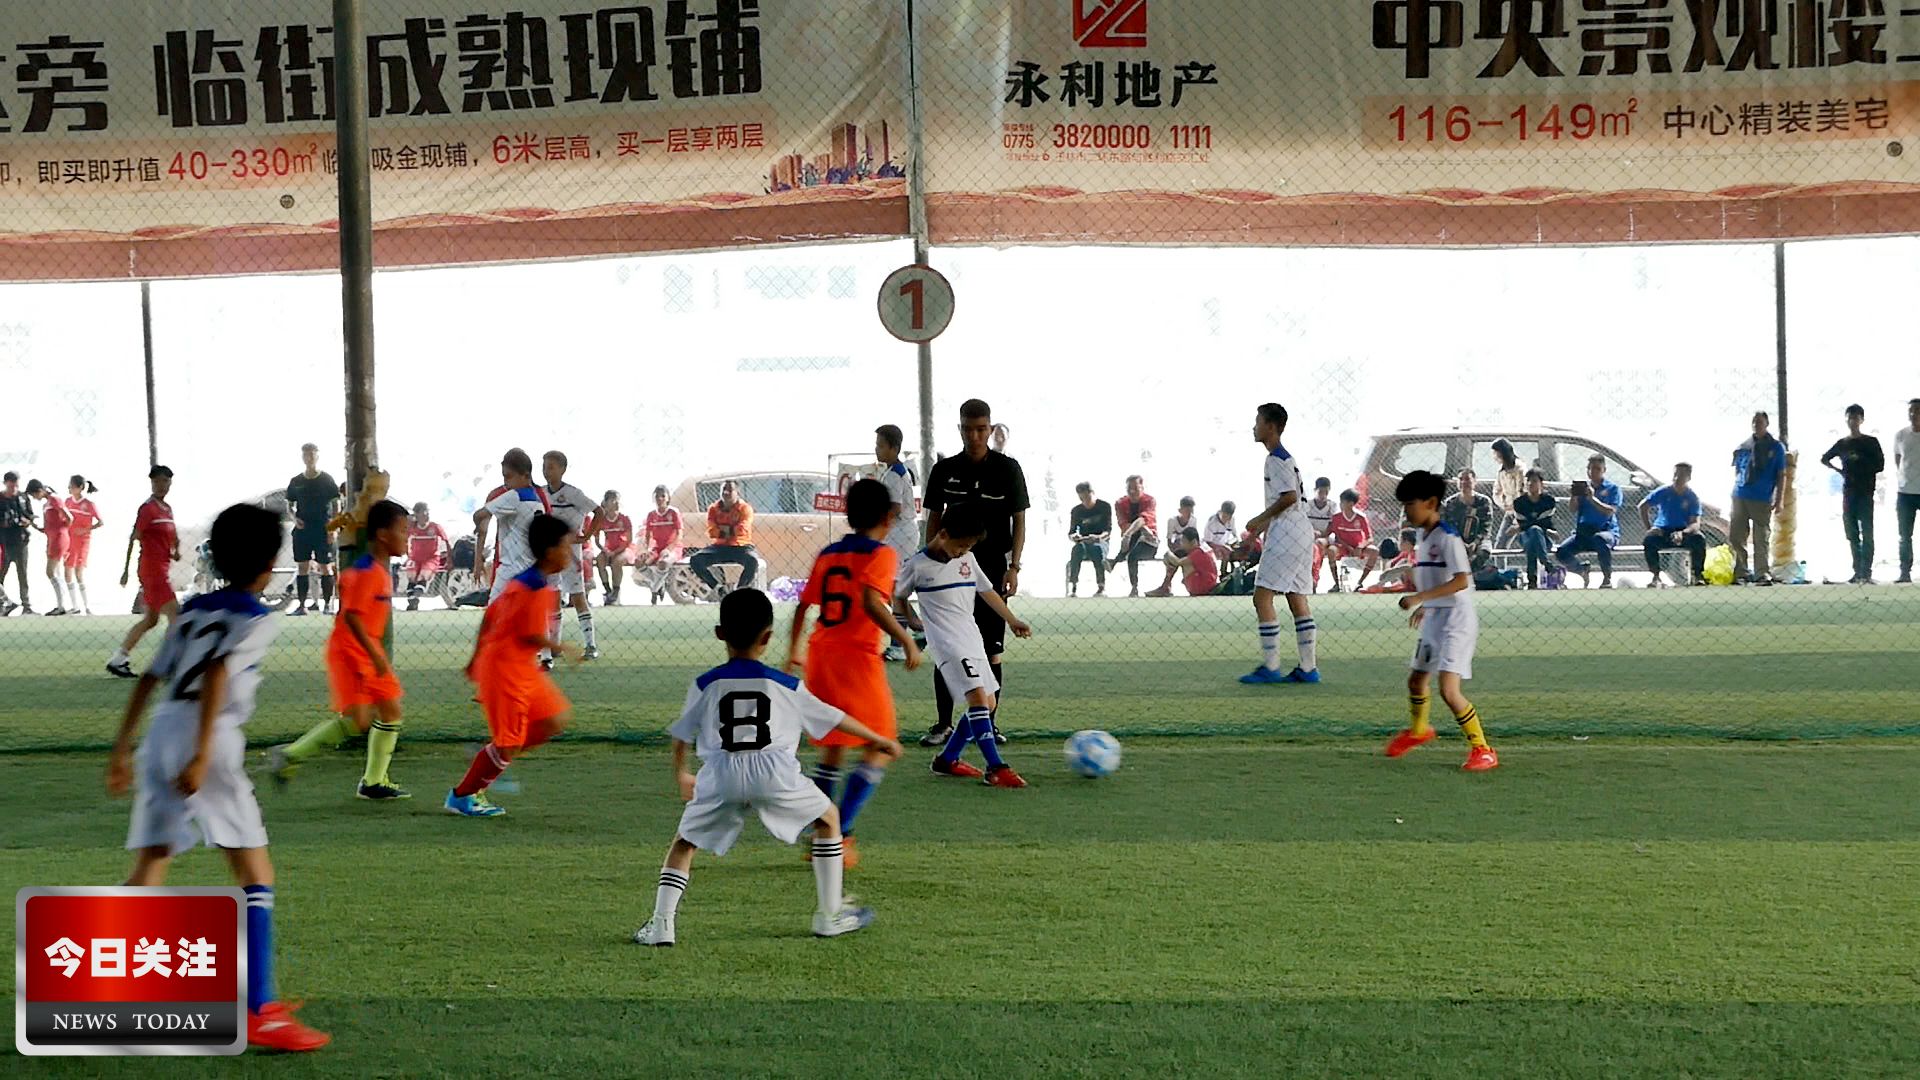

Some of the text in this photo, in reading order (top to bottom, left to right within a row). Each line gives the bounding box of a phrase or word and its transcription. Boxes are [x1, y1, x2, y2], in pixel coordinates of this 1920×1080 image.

[1004, 60, 1218, 108] 永利地产
[1053, 124, 1150, 149] 3820000
[1169, 125, 1212, 149] 1111
[1664, 98, 1888, 138] 中心精装美宅
[900, 279, 923, 330] 1
[819, 565, 852, 628] 6
[718, 691, 772, 752] 8
